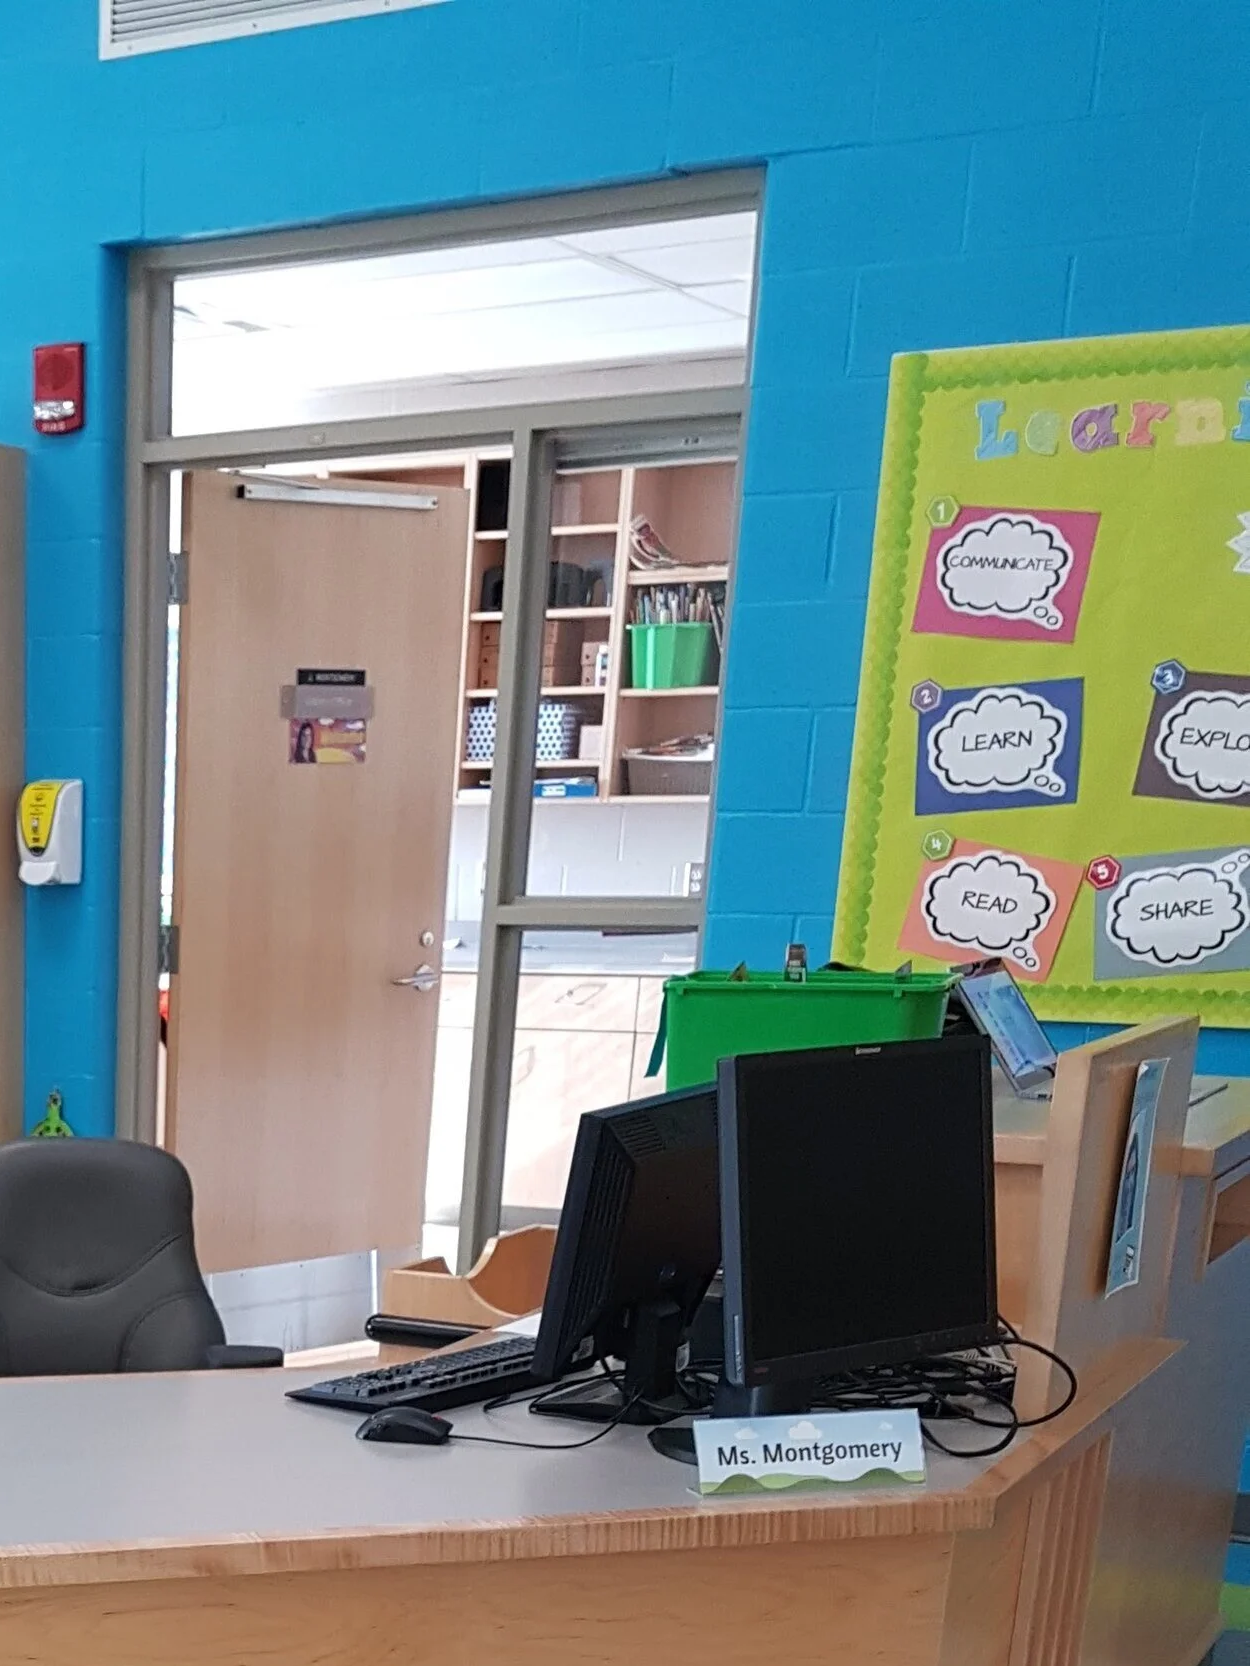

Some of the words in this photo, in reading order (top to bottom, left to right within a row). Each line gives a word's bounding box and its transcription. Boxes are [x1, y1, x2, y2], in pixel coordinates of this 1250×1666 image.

[937, 505, 945, 520] 1
[950, 554, 1054, 572] COMMUNICATE
[1162, 669, 1174, 684] 3
[921, 690, 932, 704] 2
[961, 729, 1033, 752] LEARN
[931, 838, 942, 851] 4
[1097, 864, 1109, 878] 5
[960, 890, 1018, 914] READ
[1139, 898, 1214, 921] SHARE
[717, 1445, 756, 1466] Ms.
[763, 1441, 902, 1465] Montgomery
